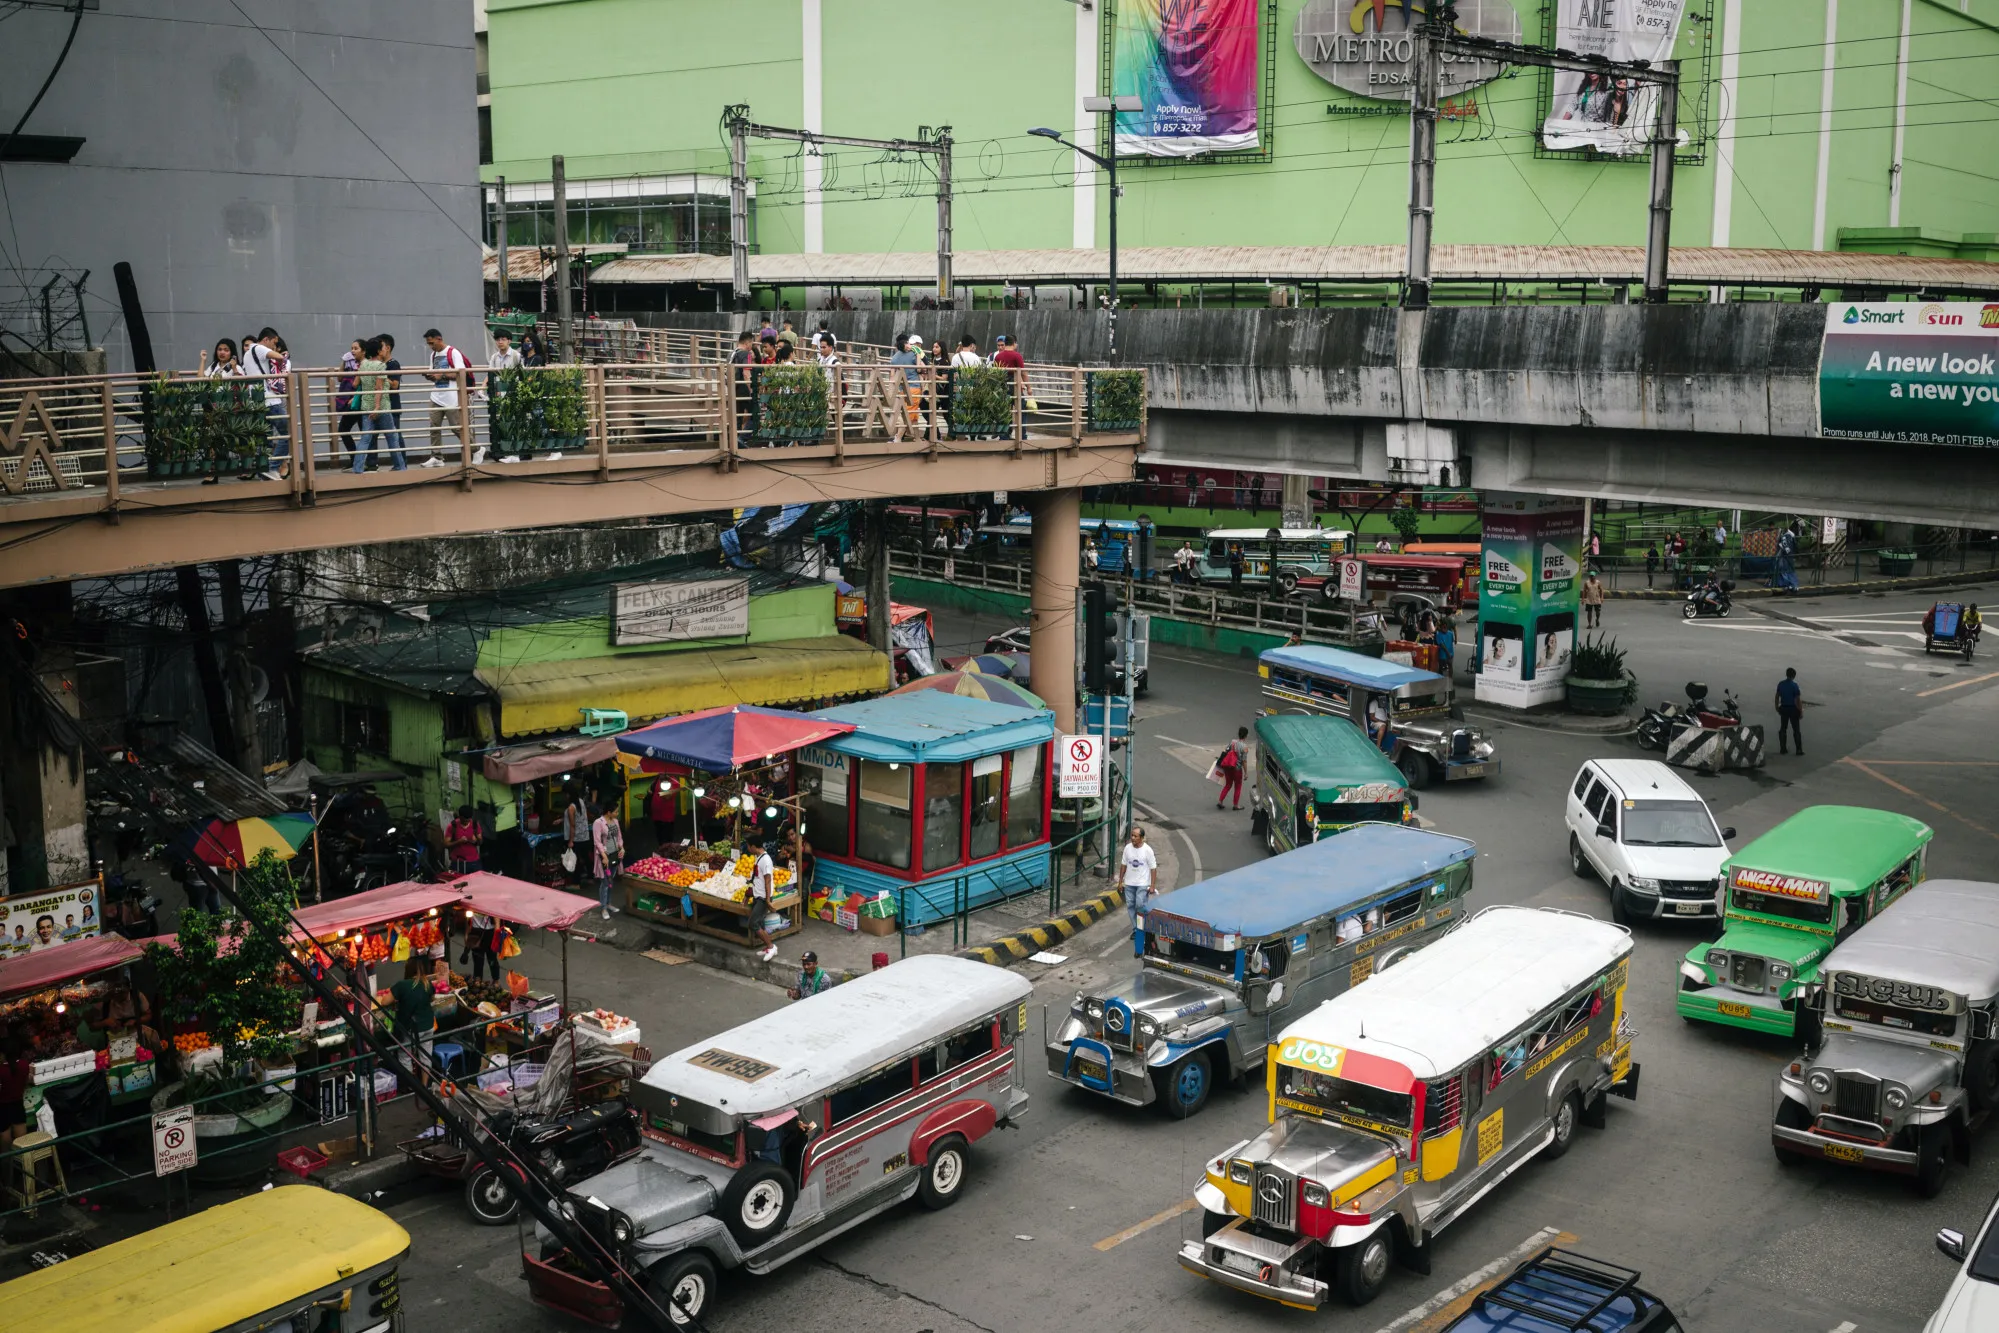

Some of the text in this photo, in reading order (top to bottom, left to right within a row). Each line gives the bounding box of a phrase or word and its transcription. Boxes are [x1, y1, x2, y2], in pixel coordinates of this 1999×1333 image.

[1369, 72, 1410, 84] EDSA
[1156, 104, 1179, 115] Apply
[1327, 104, 1382, 118] Managed
[1162, 123, 1202, 133] 857-3222
[1861, 309, 1905, 324] Smart
[1927, 313, 1963, 325] sun
[1865, 351, 1995, 375] A new look
[1890, 383, 1903, 398] a
[1909, 383, 1957, 400] new
[1823, 427, 1846, 437] Promo
[1865, 430, 1879, 438] until
[1880, 430, 1895, 441] July
[1897, 432, 1908, 441] 15,
[1910, 432, 1930, 442] 2018.
[1932, 433, 1945, 443] Per
[1947, 434, 1960, 443] DTI
[1962, 436, 1984, 445] FTEB
[1488, 561, 1510, 572] FREE
[1544, 555, 1565, 568] FREE
[1499, 574, 1518, 582] YouTube
[1552, 569, 1571, 578] YouTube
[1488, 582, 1505, 590] EVERY
[1542, 582, 1558, 590] EVERY
[623, 585, 745, 608] FELY'S CANTEEN
[645, 609, 673, 617] OPEN
[690, 604, 726, 614] HOURS
[842, 600, 859, 614] TNT
[656, 751, 704, 769] MICROMATIC
[800, 748, 846, 771] MMDA
[1072, 763, 1090, 773] NO
[1063, 774, 1098, 782] JAYWALKING
[13, 894, 76, 913] BARANGAY 83
[31, 906, 51, 916] ZONE
[1282, 1039, 1345, 1070] JOY
[1343, 1115, 1361, 1125] PASAY
[159, 1149, 170, 1158] NO
[159, 1150, 194, 1165] PARKING
[161, 1157, 193, 1170] THIS SIDE
